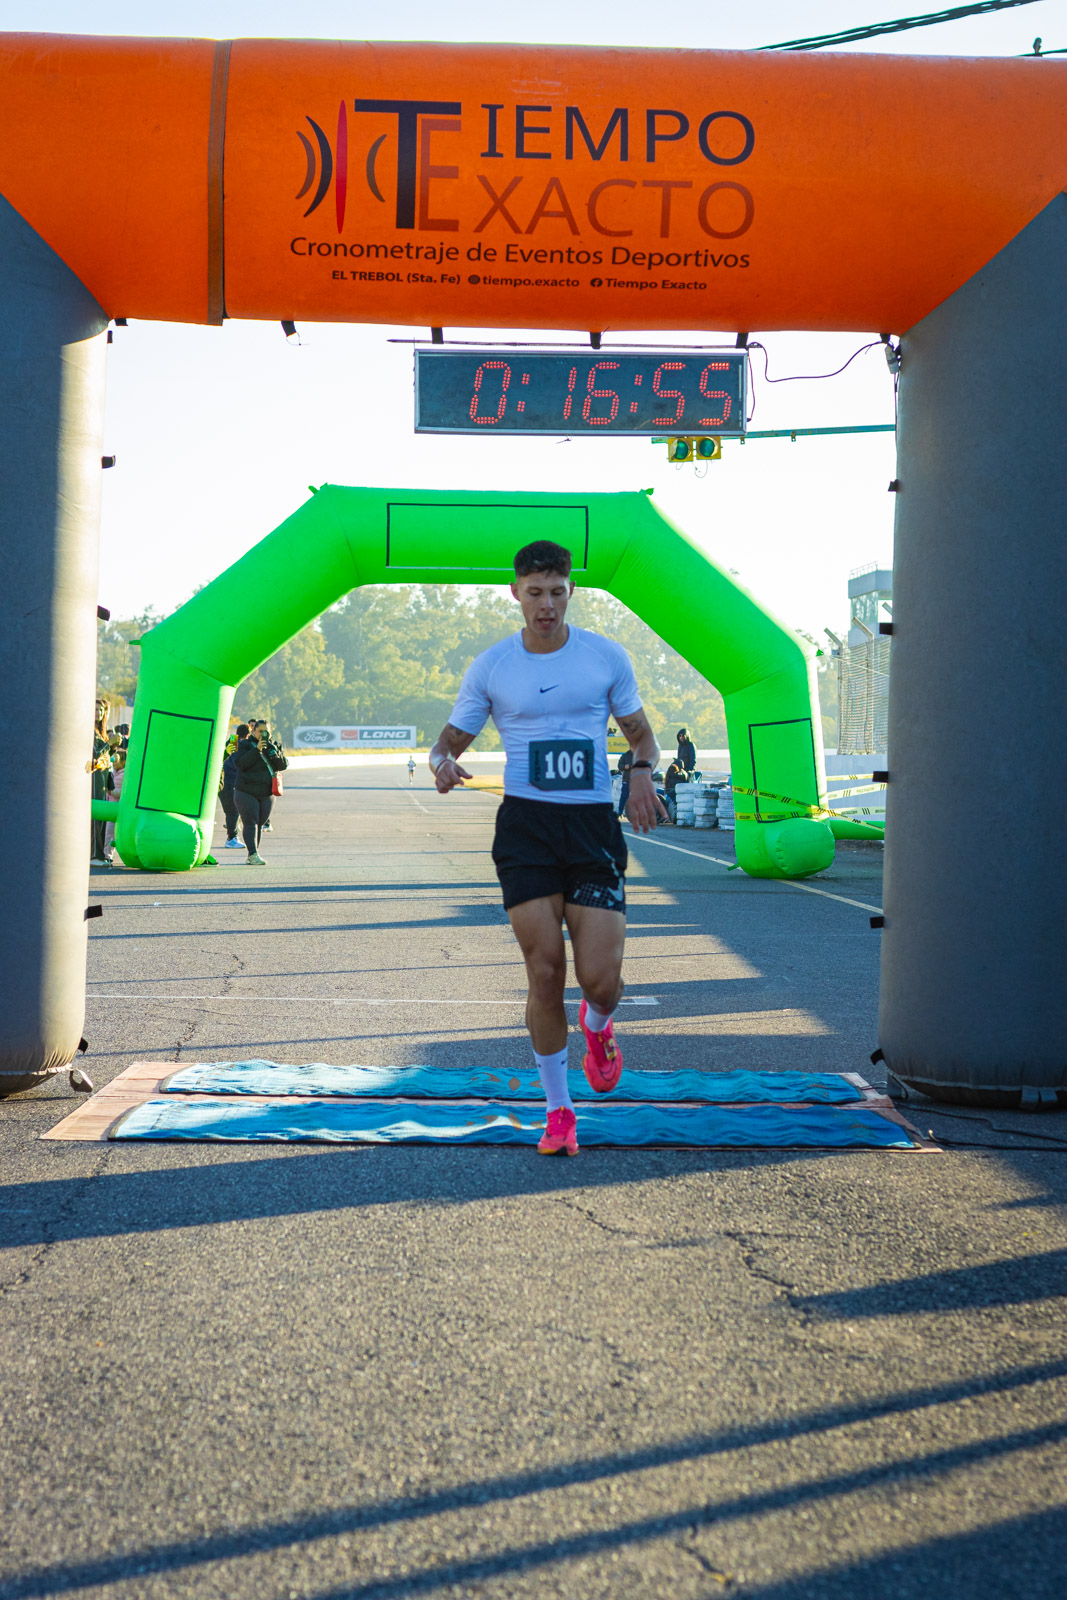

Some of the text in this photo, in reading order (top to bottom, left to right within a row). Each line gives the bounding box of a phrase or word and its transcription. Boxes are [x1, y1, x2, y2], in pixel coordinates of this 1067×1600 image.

[290, 237, 751, 270] Cronometraje de Eventos Deportivos
[332, 270, 708, 290] EL TREBOL (Sta. Fe) tiempo.exacto Tiempo Exacto
[303, 731, 408, 742] Ford LONG
[545, 750, 585, 779] 106
